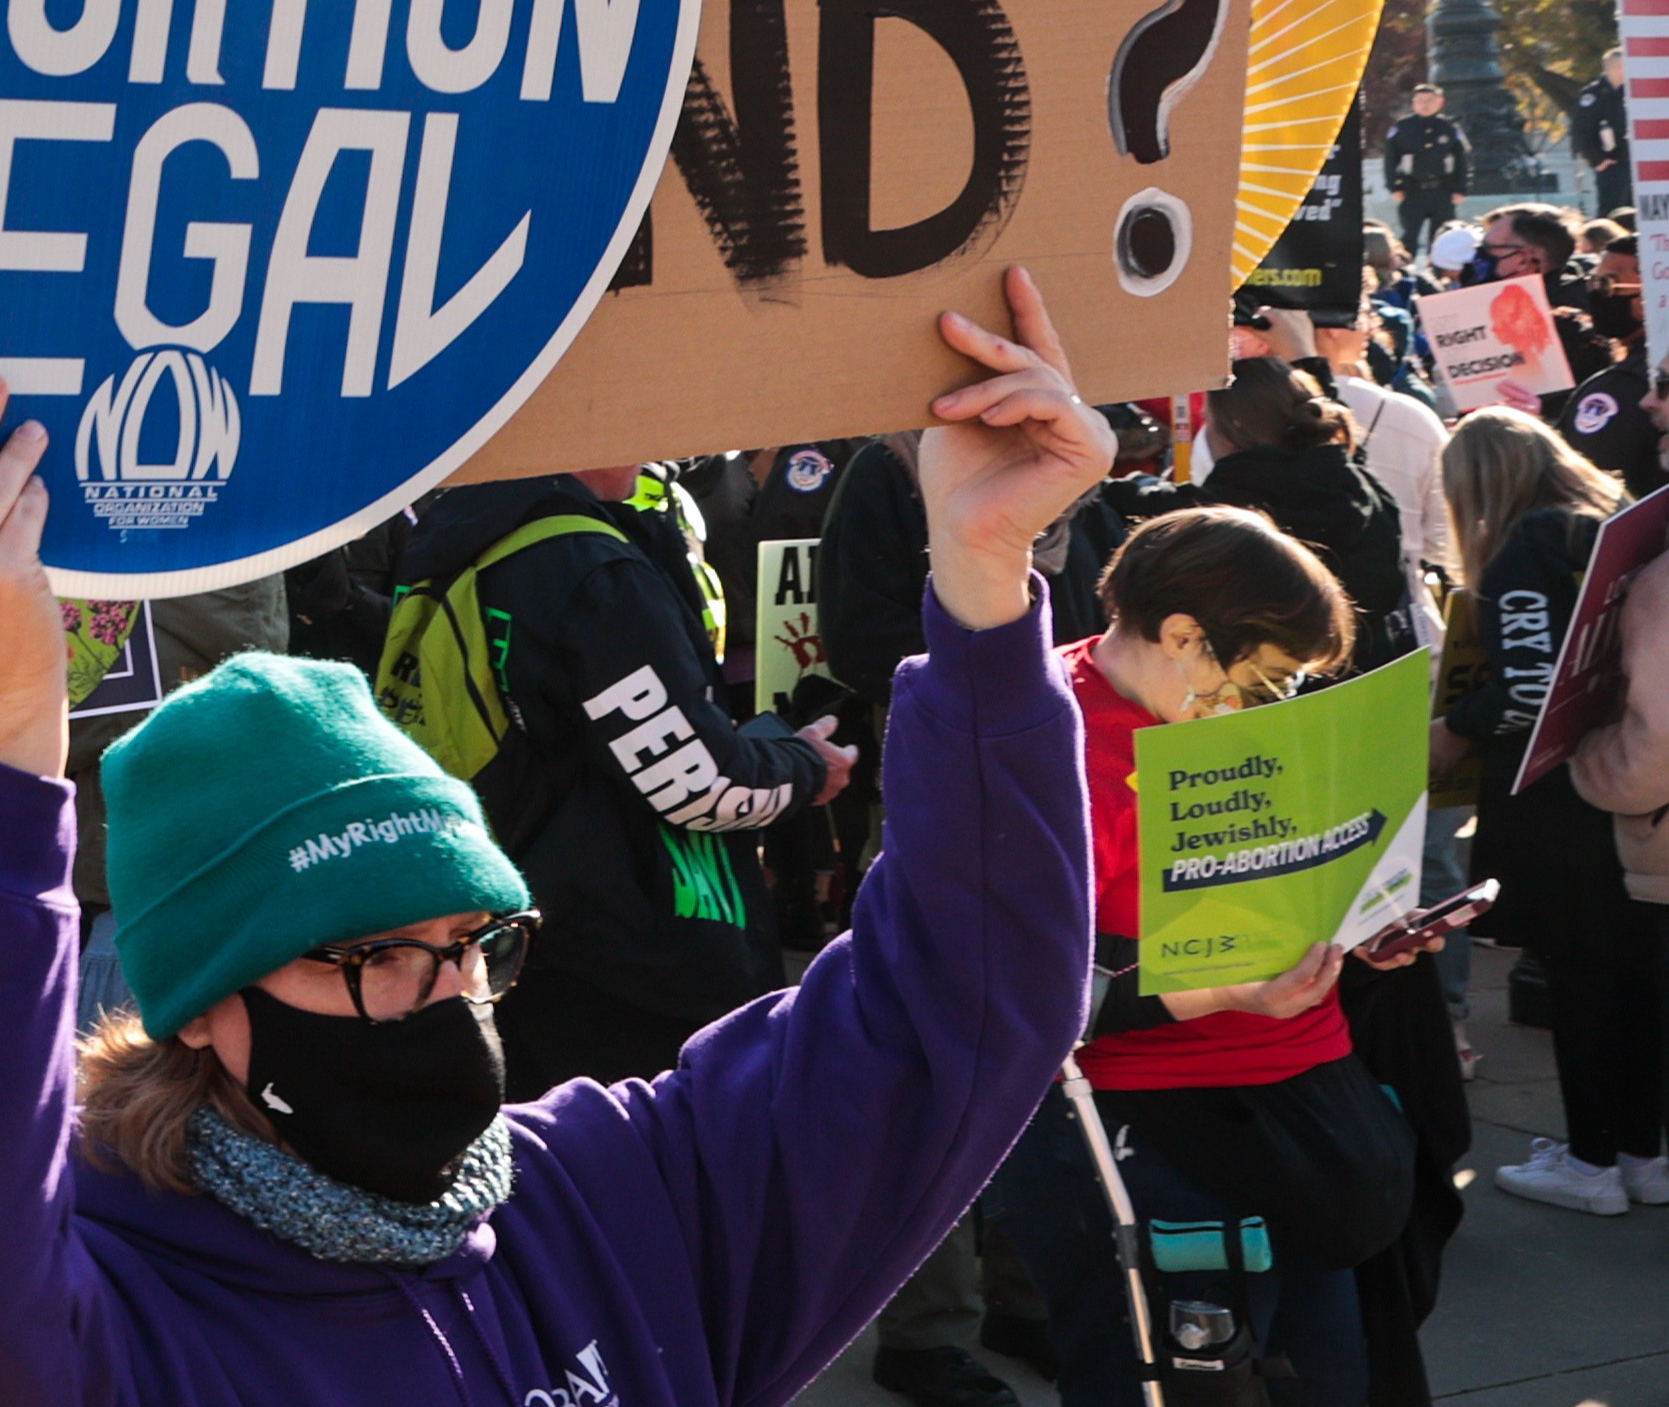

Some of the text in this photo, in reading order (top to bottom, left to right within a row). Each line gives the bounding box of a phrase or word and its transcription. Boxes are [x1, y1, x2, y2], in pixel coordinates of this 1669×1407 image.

[1436, 325, 1487, 348] RIGHT
[1447, 352, 1526, 379] DECISION
[74, 350, 241, 481] NOW
[84, 485, 218, 500] NATIONAL
[93, 502, 206, 515] ORGANIZATION
[109, 516, 190, 527] FOR WOMEN
[1499, 589, 1553, 653] CRY
[1169, 755, 1284, 791] Proudly,
[1170, 789, 1272, 822] Loudly,
[1170, 811, 1372, 882] PRO-ABORTION ACCESS
[1171, 815, 1298, 853] Jewishly,
